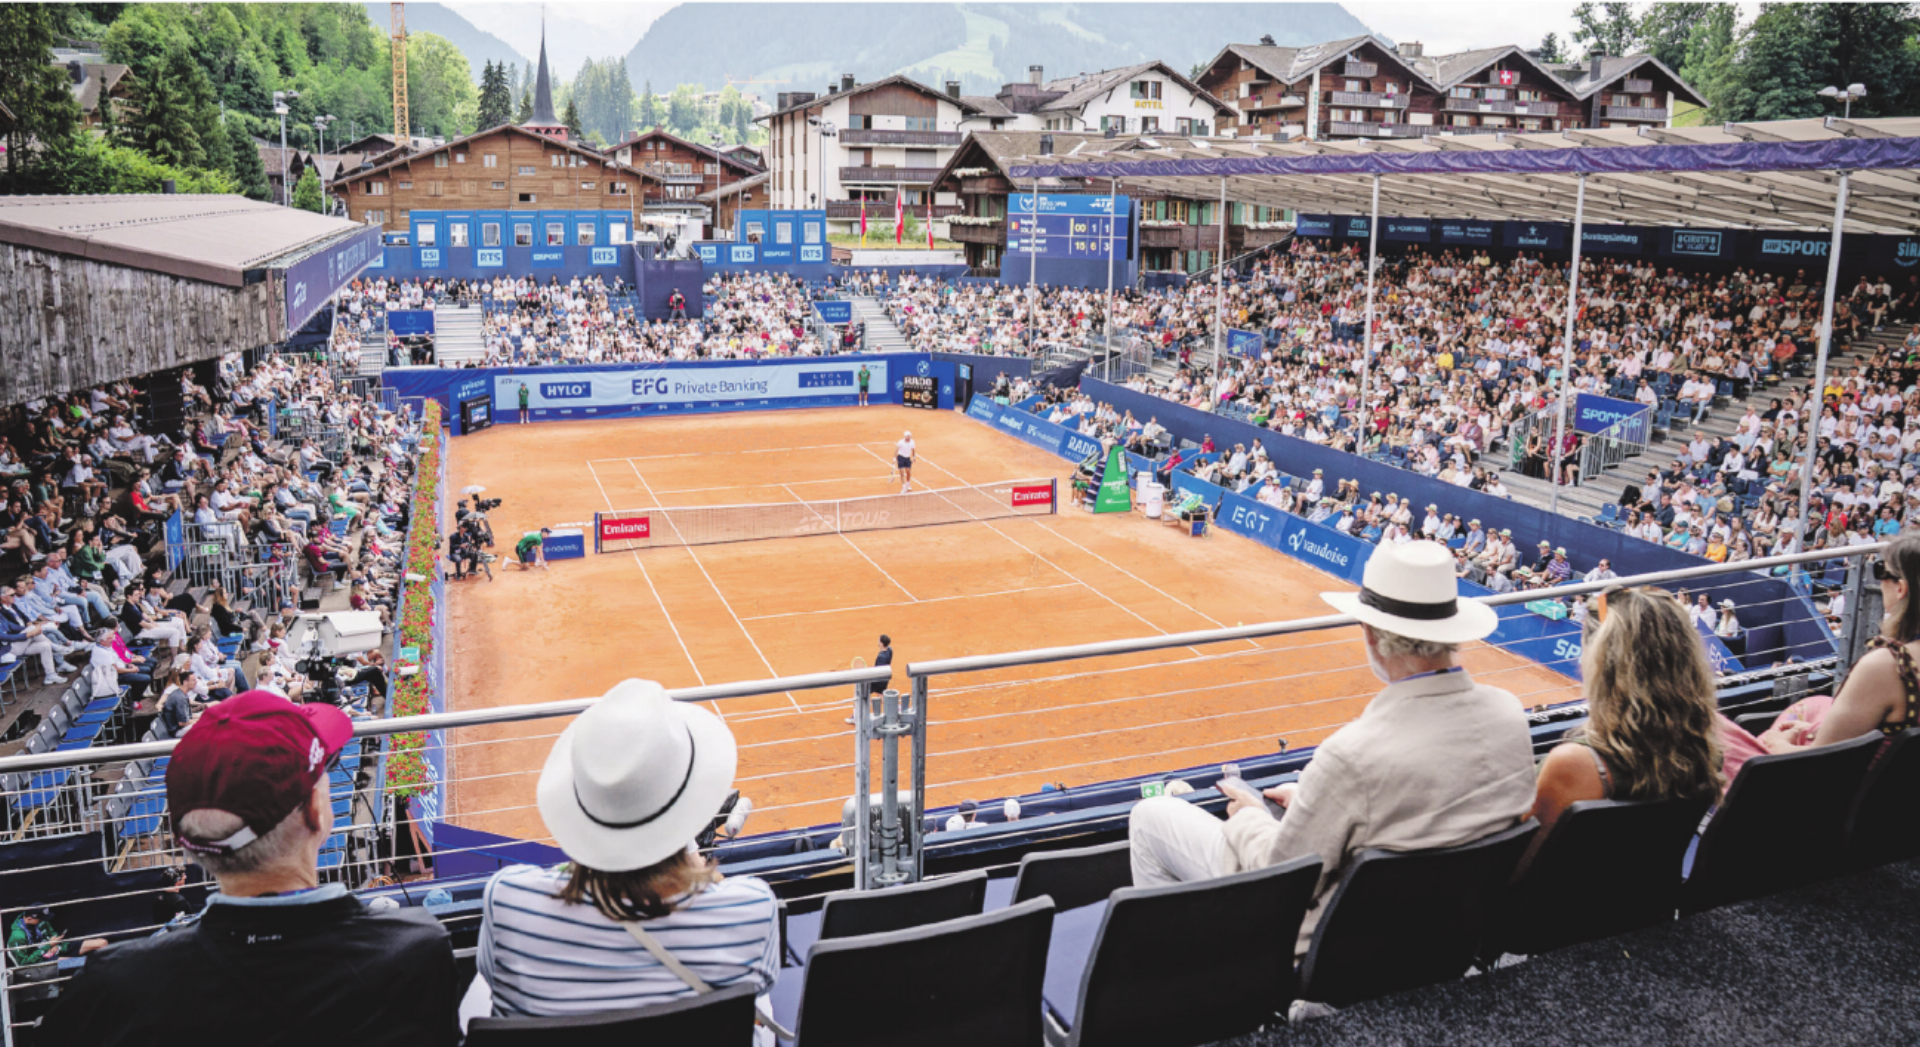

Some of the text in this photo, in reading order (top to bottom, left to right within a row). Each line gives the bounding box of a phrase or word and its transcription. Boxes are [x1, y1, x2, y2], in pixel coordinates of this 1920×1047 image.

[1135, 101, 1163, 109] HOTEL
[1074, 223, 1087, 232] 00
[1091, 224, 1097, 233] 1
[1075, 241, 1086, 251] 15
[1090, 242, 1097, 251] 6
[1781, 239, 1833, 256] SPOR
[480, 252, 501, 262] RTS
[594, 251, 614, 261] RTS
[735, 250, 753, 259] RTS
[803, 249, 822, 258] RTS
[631, 377, 769, 395] EFG Private Banking
[1067, 435, 1097, 456] RADO
[1014, 490, 1050, 501] Emirates
[841, 511, 891, 528] TOUR
[1231, 505, 1271, 533] EQT
[604, 522, 648, 535] Emirates
[1302, 540, 1349, 567] vaudoise
